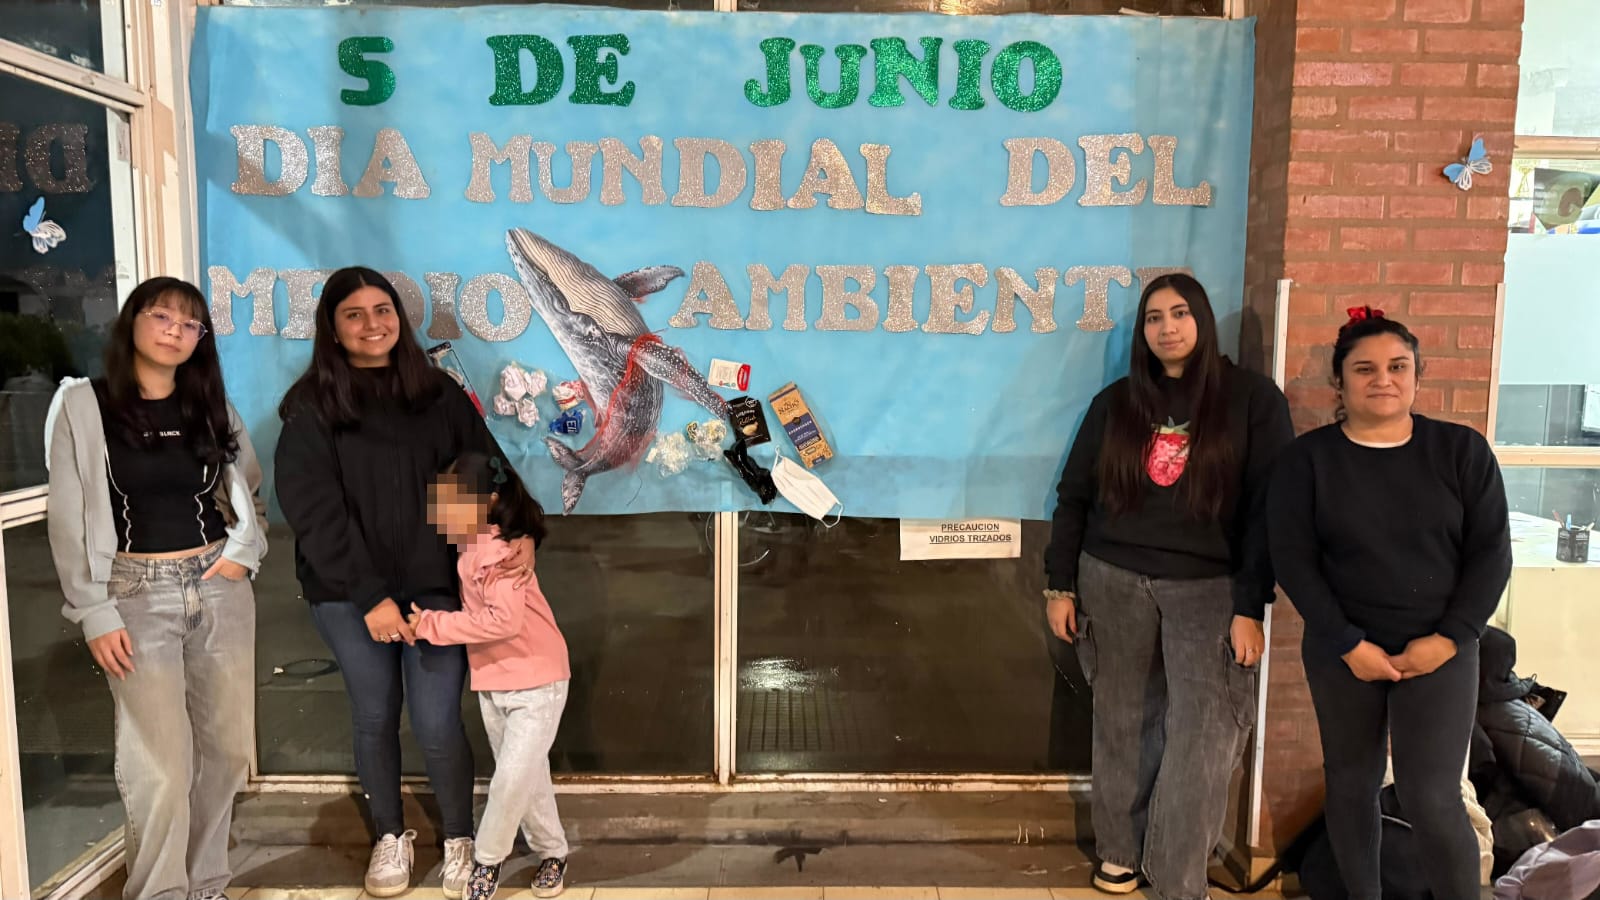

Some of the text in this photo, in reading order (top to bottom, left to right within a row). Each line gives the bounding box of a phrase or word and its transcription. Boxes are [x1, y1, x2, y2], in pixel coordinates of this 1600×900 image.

[487, 34, 635, 107] DE
[744, 37, 1063, 112] JUNIO
[230, 124, 1212, 216] DIA MUNDIAL DEL
[668, 260, 1194, 336] AMBIENT
[929, 533, 1012, 544] VIDRIOS TRIZADOS
[941, 522, 1000, 532] PRECAUCION
